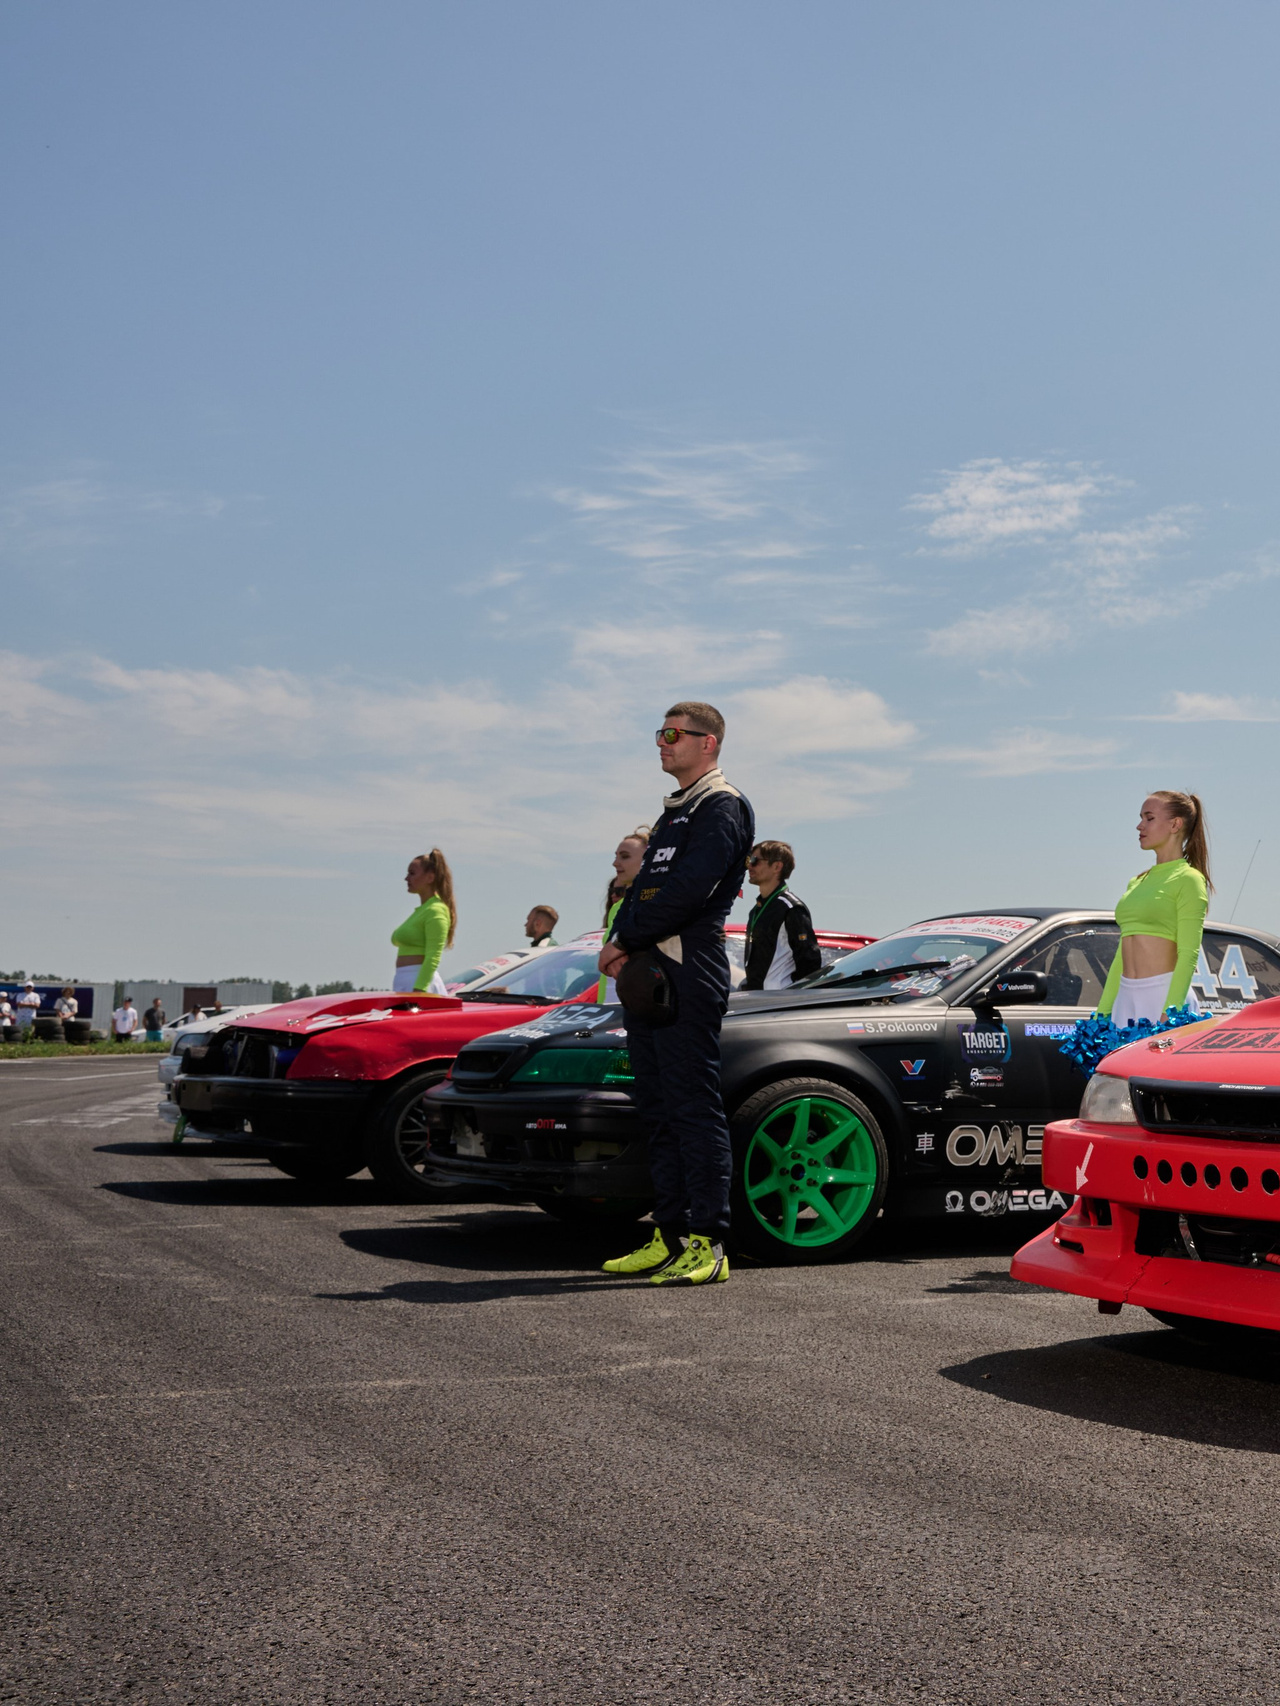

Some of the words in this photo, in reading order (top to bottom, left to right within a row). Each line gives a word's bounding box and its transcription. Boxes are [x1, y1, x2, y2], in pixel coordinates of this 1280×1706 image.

[891, 975, 944, 995] 44
[1008, 983, 1035, 991] Valvoline
[306, 1008, 393, 1030] 24
[865, 1022, 938, 1034] S.Poklonov
[962, 1032, 1008, 1049] TARGET
[915, 1132, 935, 1155] 車
[946, 1125, 1046, 1166] OME
[970, 1189, 1068, 1215] OMEGA
